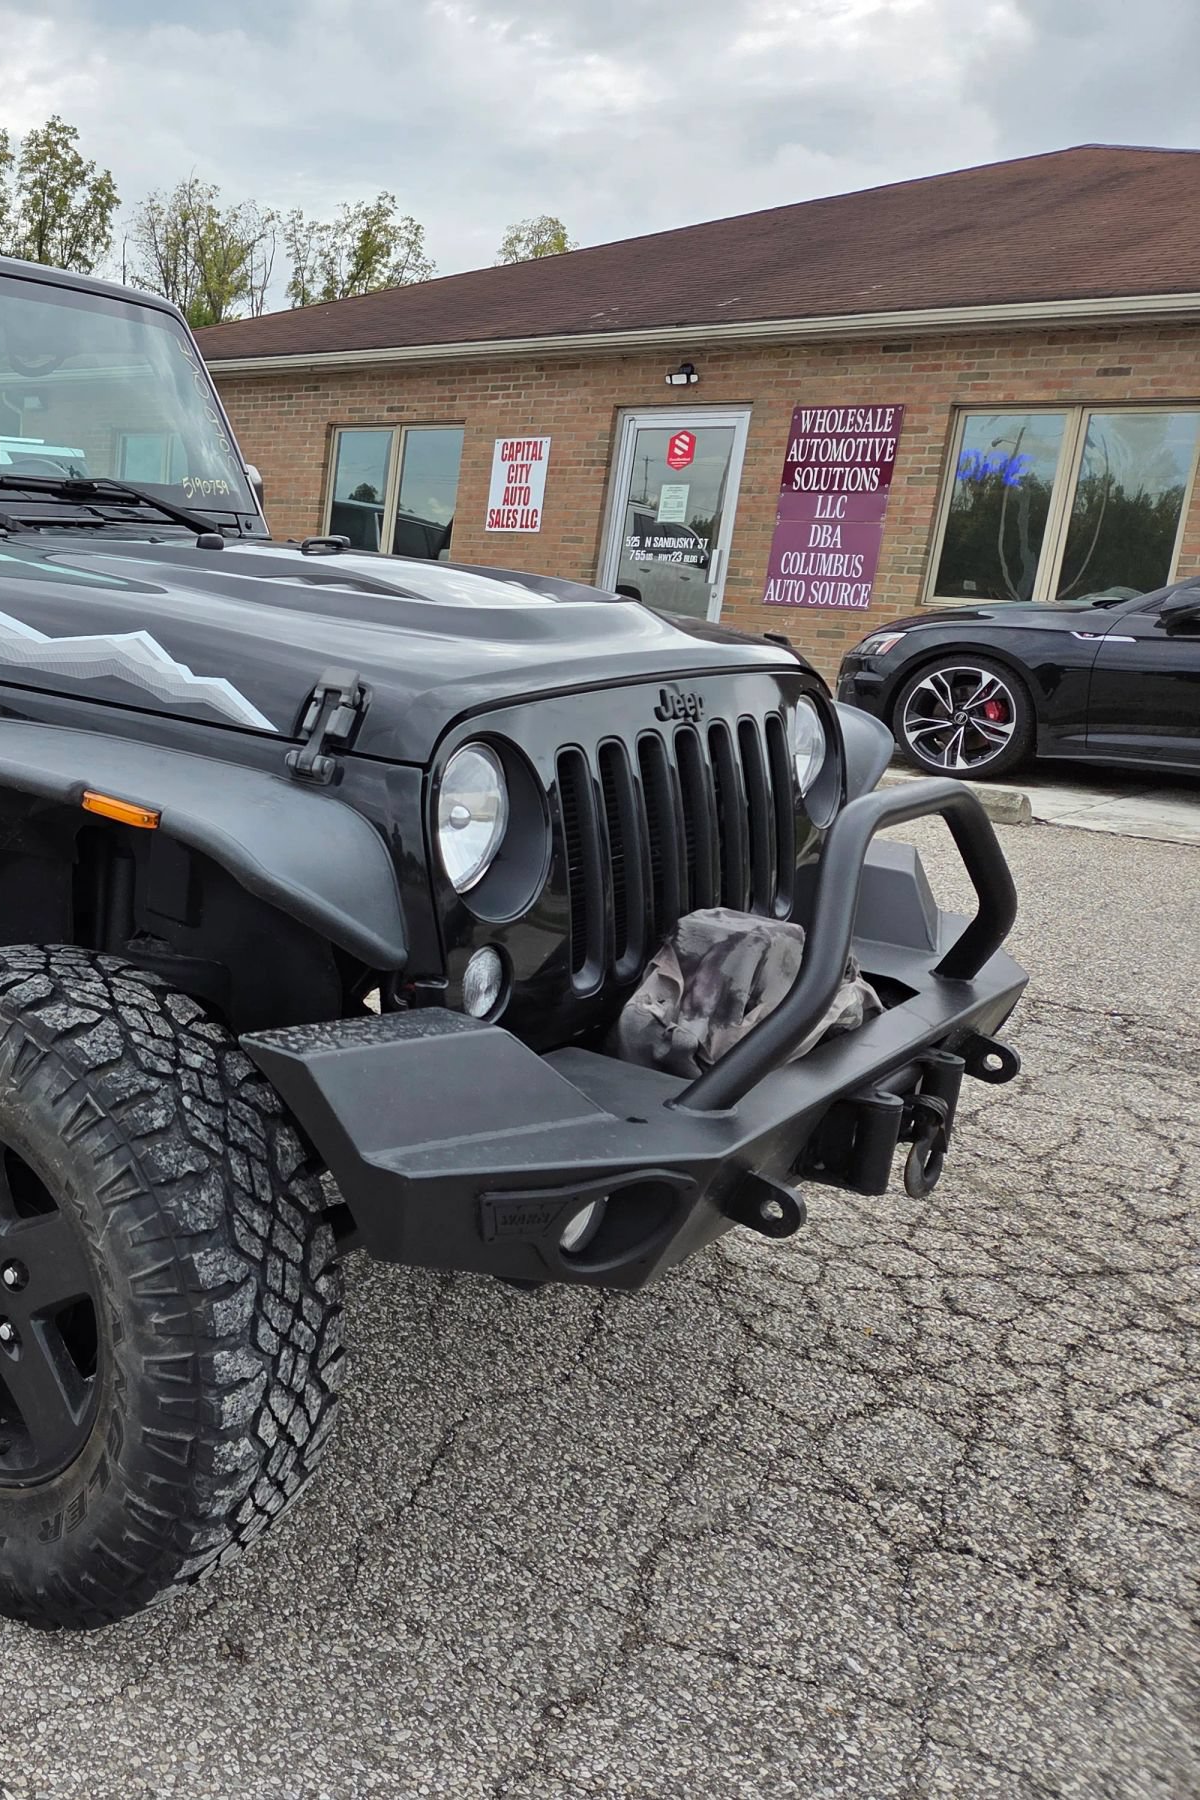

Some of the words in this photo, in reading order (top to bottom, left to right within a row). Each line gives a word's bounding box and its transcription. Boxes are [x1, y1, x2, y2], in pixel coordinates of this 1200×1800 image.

[801, 408, 895, 433] WHOLESALE
[501, 441, 543, 462] CAPITAL
[786, 438, 896, 462] AUTOMOTIVE
[507, 463, 532, 484] CITY
[792, 467, 880, 491] SOLUTIONS
[182, 476, 230, 499] 5190759
[502, 486, 531, 506] AUTO
[488, 508, 518, 529] SALES
[519, 508, 538, 529] LLC
[814, 494, 848, 519] LLC
[625, 536, 641, 547] 525
[644, 536, 652, 548] N
[653, 537, 695, 549] SANDUSKY
[697, 538, 709, 549] ST
[808, 524, 842, 548] DBA
[780, 551, 864, 578] COLUMBUS
[764, 579, 806, 602] AUTO
[808, 581, 871, 608] SOURCE
[653, 688, 704, 723] Jeep
